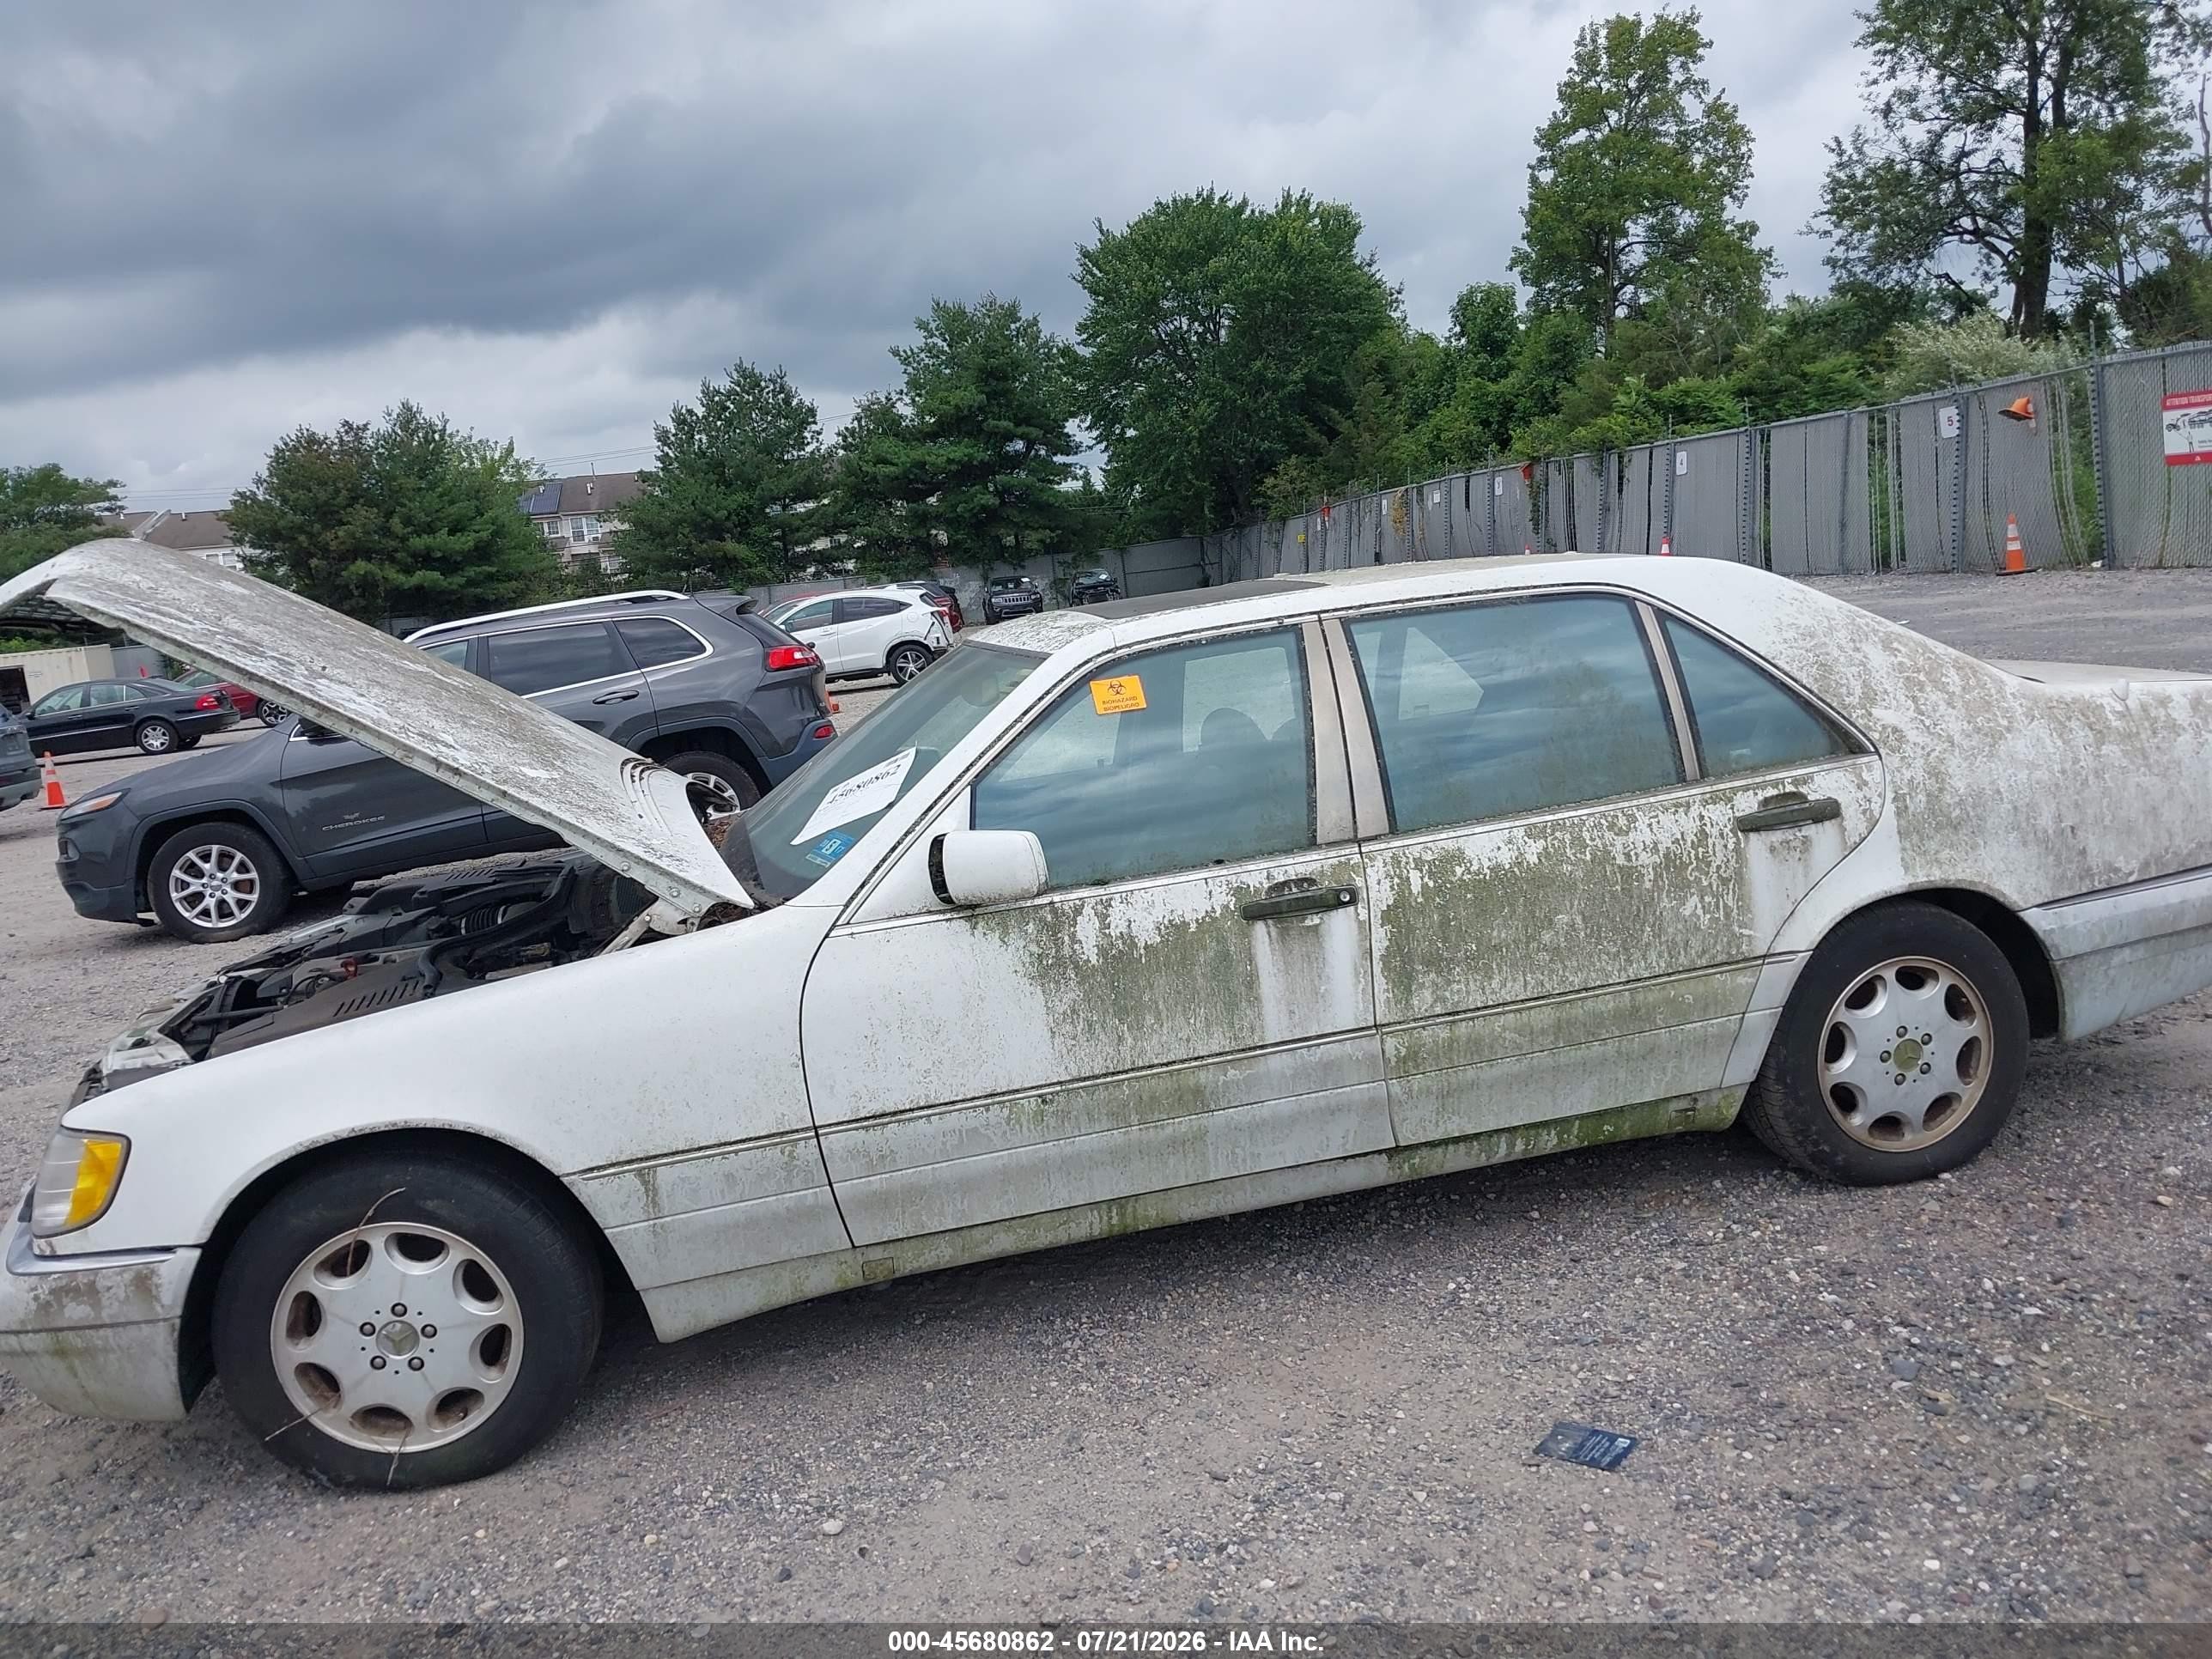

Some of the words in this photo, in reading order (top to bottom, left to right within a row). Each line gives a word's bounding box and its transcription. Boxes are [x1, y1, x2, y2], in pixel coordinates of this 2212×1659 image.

[1947, 416, 1954, 427] 5
[1102, 696, 1138, 705] BIOHAZARD
[1103, 702, 1140, 712] BIOPELIGRO
[322, 815, 386, 831] CHEROKEE
